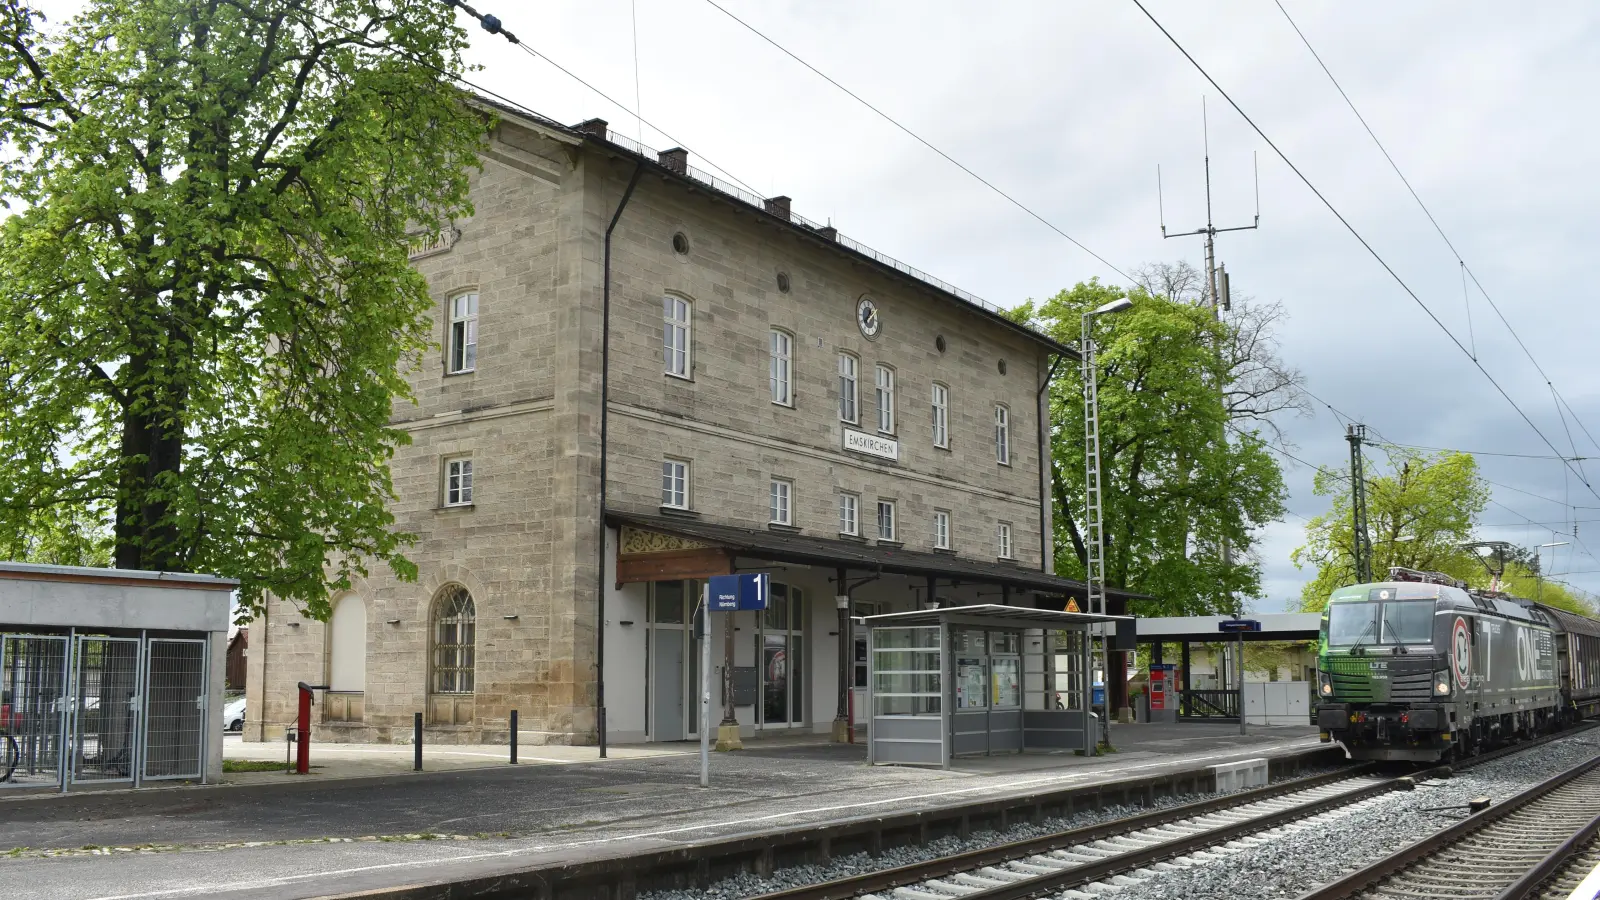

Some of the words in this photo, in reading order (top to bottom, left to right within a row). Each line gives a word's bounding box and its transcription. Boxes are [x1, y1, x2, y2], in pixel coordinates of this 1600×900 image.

[849, 434, 893, 454] EMSKIRCHEN
[753, 574, 762, 601] 1
[1517, 626, 1541, 680] ONE
[1369, 661, 1388, 669] LTE
